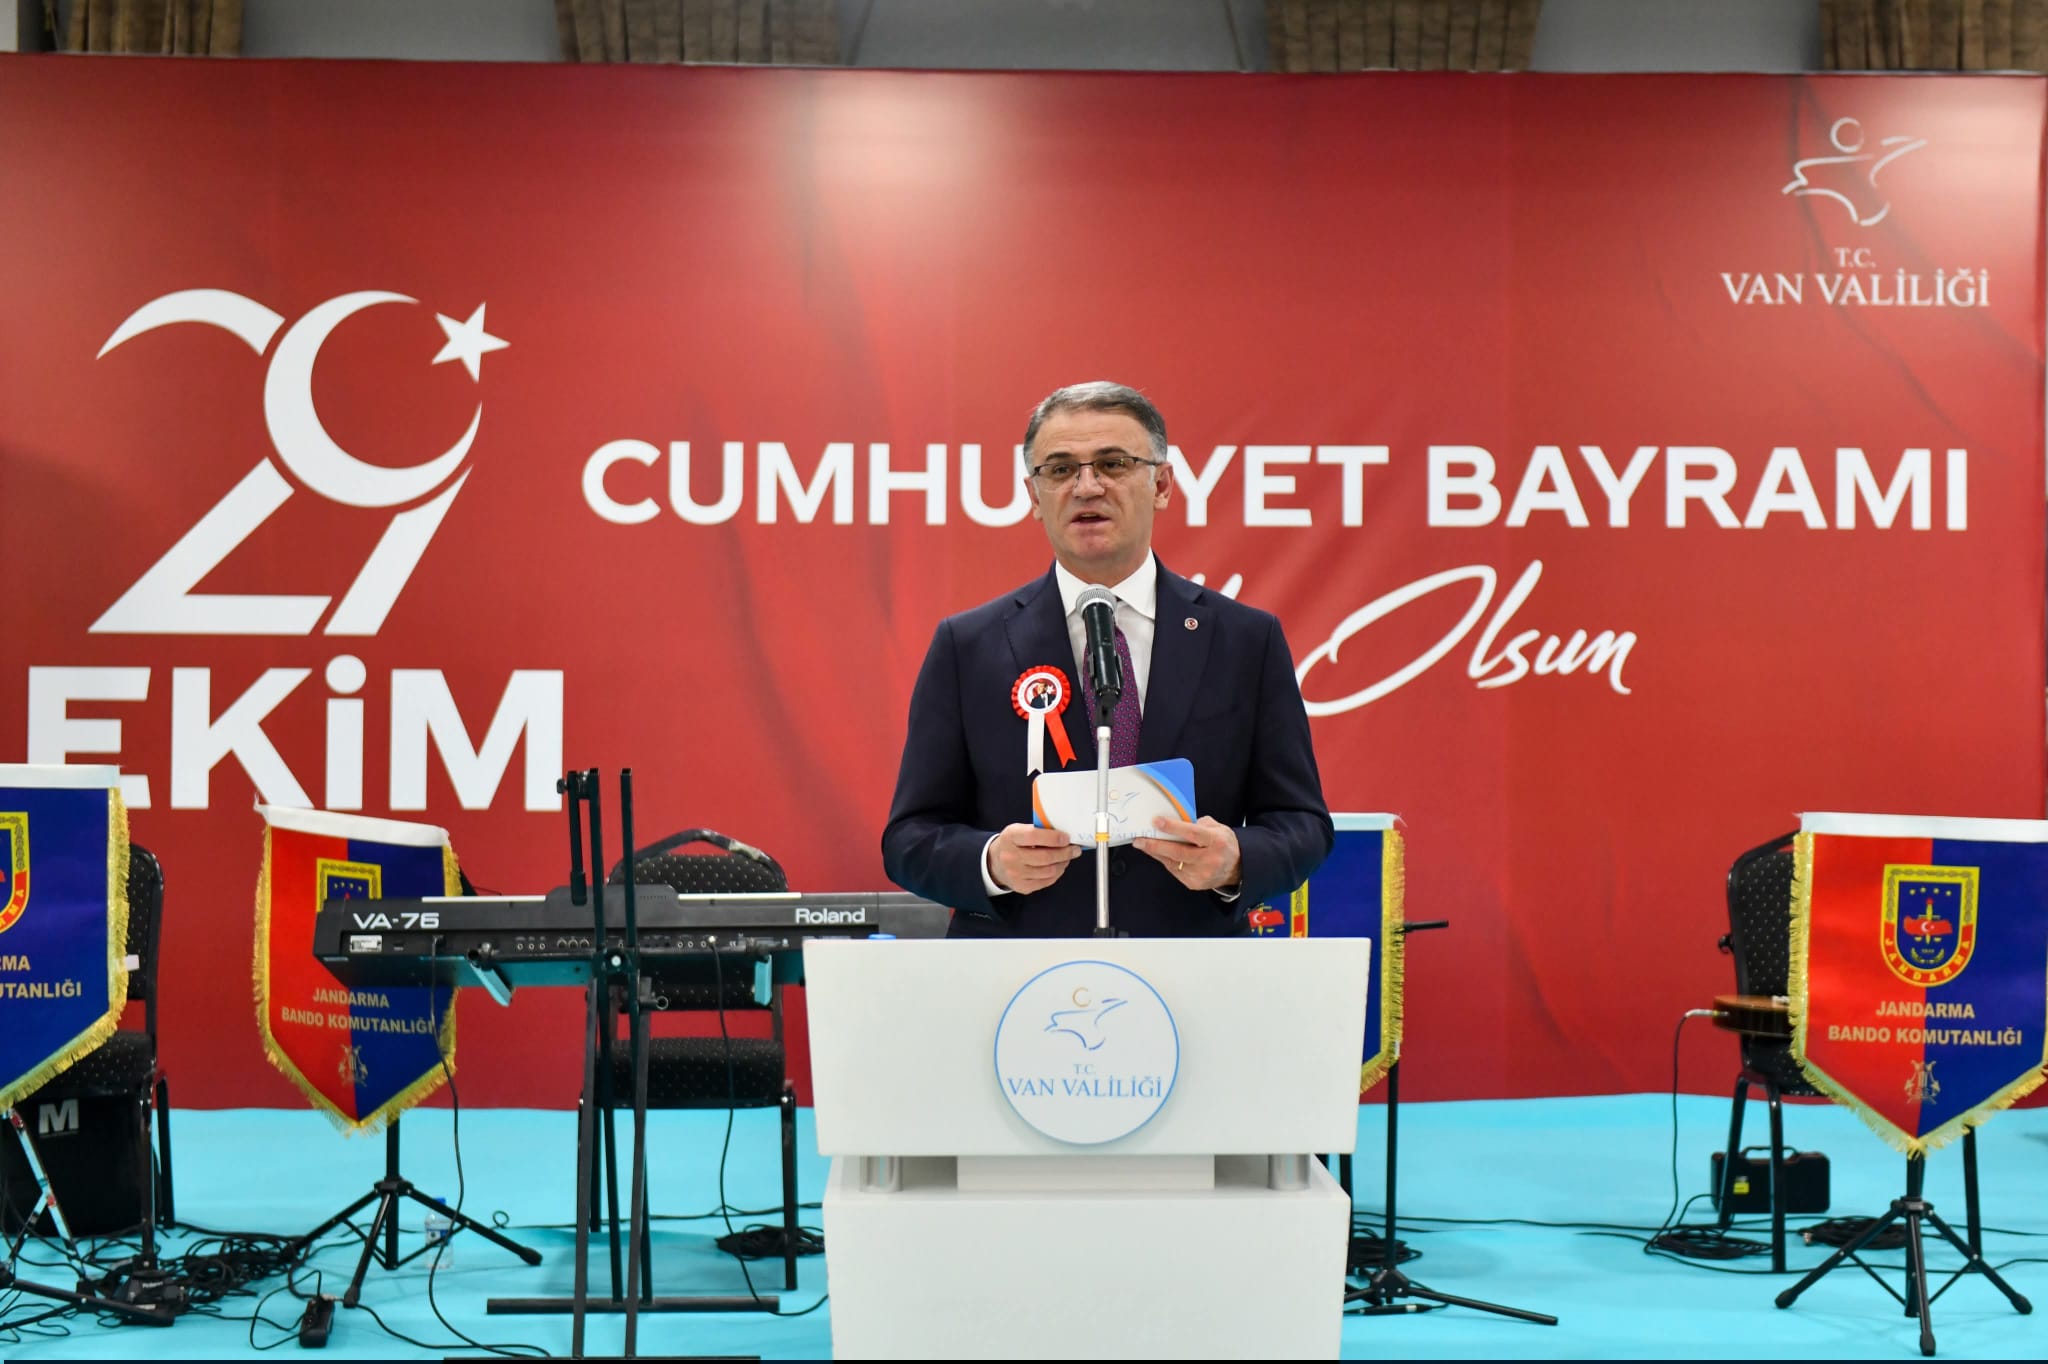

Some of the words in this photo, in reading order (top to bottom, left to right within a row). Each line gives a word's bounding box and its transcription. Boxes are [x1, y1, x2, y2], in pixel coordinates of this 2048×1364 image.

[1834, 247, 1876, 268] T.C.
[1721, 272, 1803, 305] VAN
[1815, 268, 1990, 307] VALİLİĞİ
[581, 439, 1389, 528] CUMHUYET
[1427, 445, 1968, 530] BAYRAMI
[1296, 559, 1637, 717] Olsun
[352, 912, 440, 929] VA-76
[795, 908, 866, 924] Roland
[313, 988, 390, 1008] JANDARMA
[282, 1007, 324, 1026] BANDO
[328, 1014, 434, 1034] KOMUTANLIĞI
[1876, 1001, 1975, 1019] JANDARMA
[1828, 1025, 1890, 1043] BANDO
[1896, 1026, 2022, 1045] KOMUTANLIĞI
[1007, 1077, 1055, 1096] VAN
[1063, 1075, 1162, 1098] VALİLİĞİ
